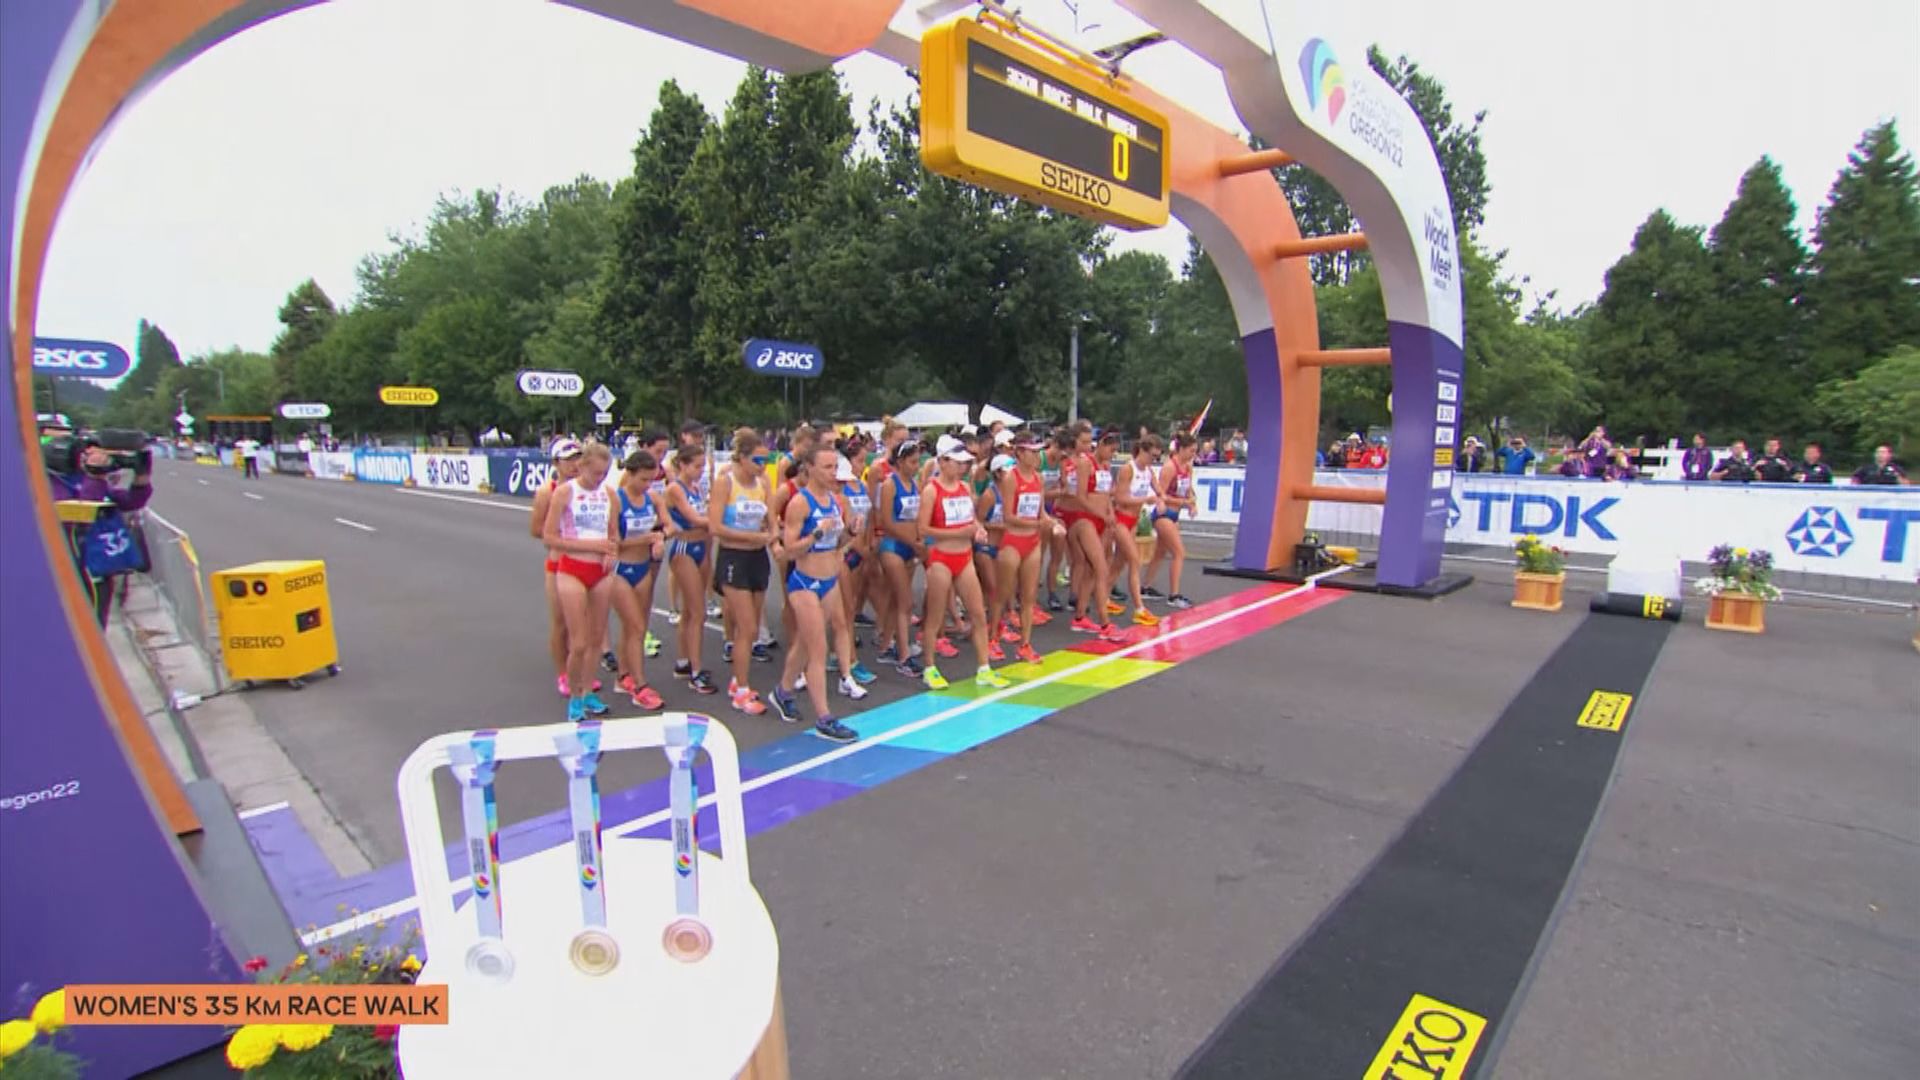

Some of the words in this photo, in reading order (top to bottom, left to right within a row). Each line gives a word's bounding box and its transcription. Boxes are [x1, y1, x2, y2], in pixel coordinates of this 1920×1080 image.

[1113, 133, 1130, 181] 0
[1041, 162, 1111, 206] SEIKO
[34, 347, 108, 369] asics
[775, 350, 814, 369] asics
[545, 376, 578, 391] QNB
[385, 389, 433, 402] SEIKO
[440, 459, 470, 485] QNB
[1462, 491, 1621, 541] TDK
[284, 572, 325, 593] SEIKO
[230, 635, 285, 649] SEIKO
